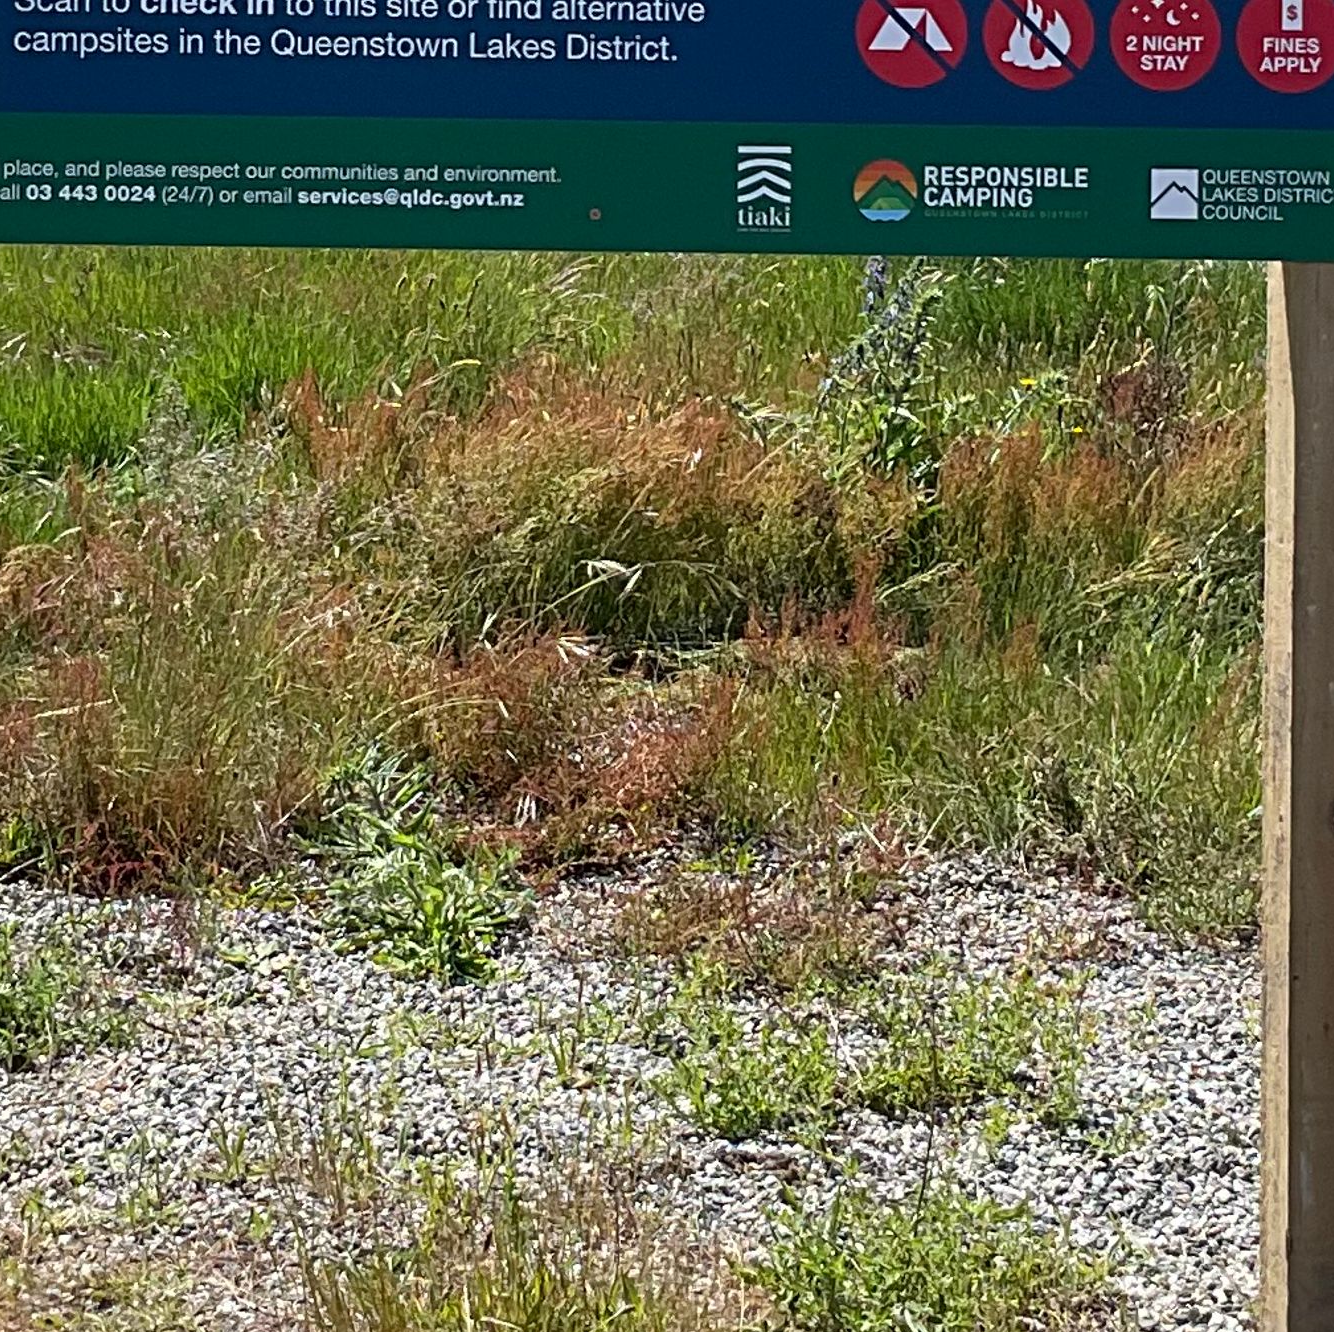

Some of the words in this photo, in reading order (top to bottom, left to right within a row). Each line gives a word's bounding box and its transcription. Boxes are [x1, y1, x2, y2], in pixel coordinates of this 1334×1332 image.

[102, 0, 131, 14] to
[140, 0, 238, 15] check
[286, 0, 314, 16] to
[323, 0, 377, 18] this
[386, 0, 439, 18] site
[447, 0, 479, 19] or
[486, 0, 542, 20] find
[551, 0, 706, 23] alternative
[13, 26, 169, 59] campsites
[179, 27, 204, 54] in
[213, 28, 261, 55] the
[270, 28, 458, 58] Queenstown
[469, 32, 557, 60] Lakes
[566, 33, 678, 61] District.
[1126, 35, 1138, 51] 2
[1142, 35, 1204, 52] NIGHT
[1263, 37, 1320, 54] FINES
[1140, 54, 1189, 71] STAY
[1259, 56, 1321, 73] APPLY
[3, 159, 59, 180] place,
[64, 160, 100, 177] and
[105, 160, 167, 181] please
[171, 162, 241, 182] respect
[244, 165, 277, 179] our
[281, 163, 399, 181] communities
[403, 164, 439, 182] and
[443, 164, 562, 184] environment.
[924, 166, 1089, 188] RESPONSIBLE
[1202, 169, 1330, 186] QUEENSTOWN
[25, 183, 53, 201] 03
[58, 184, 98, 202] 443
[103, 184, 157, 202] 0024
[161, 185, 214, 206] (24/7)
[218, 189, 239, 203] or
[242, 186, 292, 204] email
[297, 187, 525, 210] services@qldc.govt.nz
[924, 187, 1033, 208] CAMPING
[1202, 187, 1259, 203] LAKES
[737, 205, 791, 227] tiaki
[1202, 204, 1284, 221] COUNCIL
